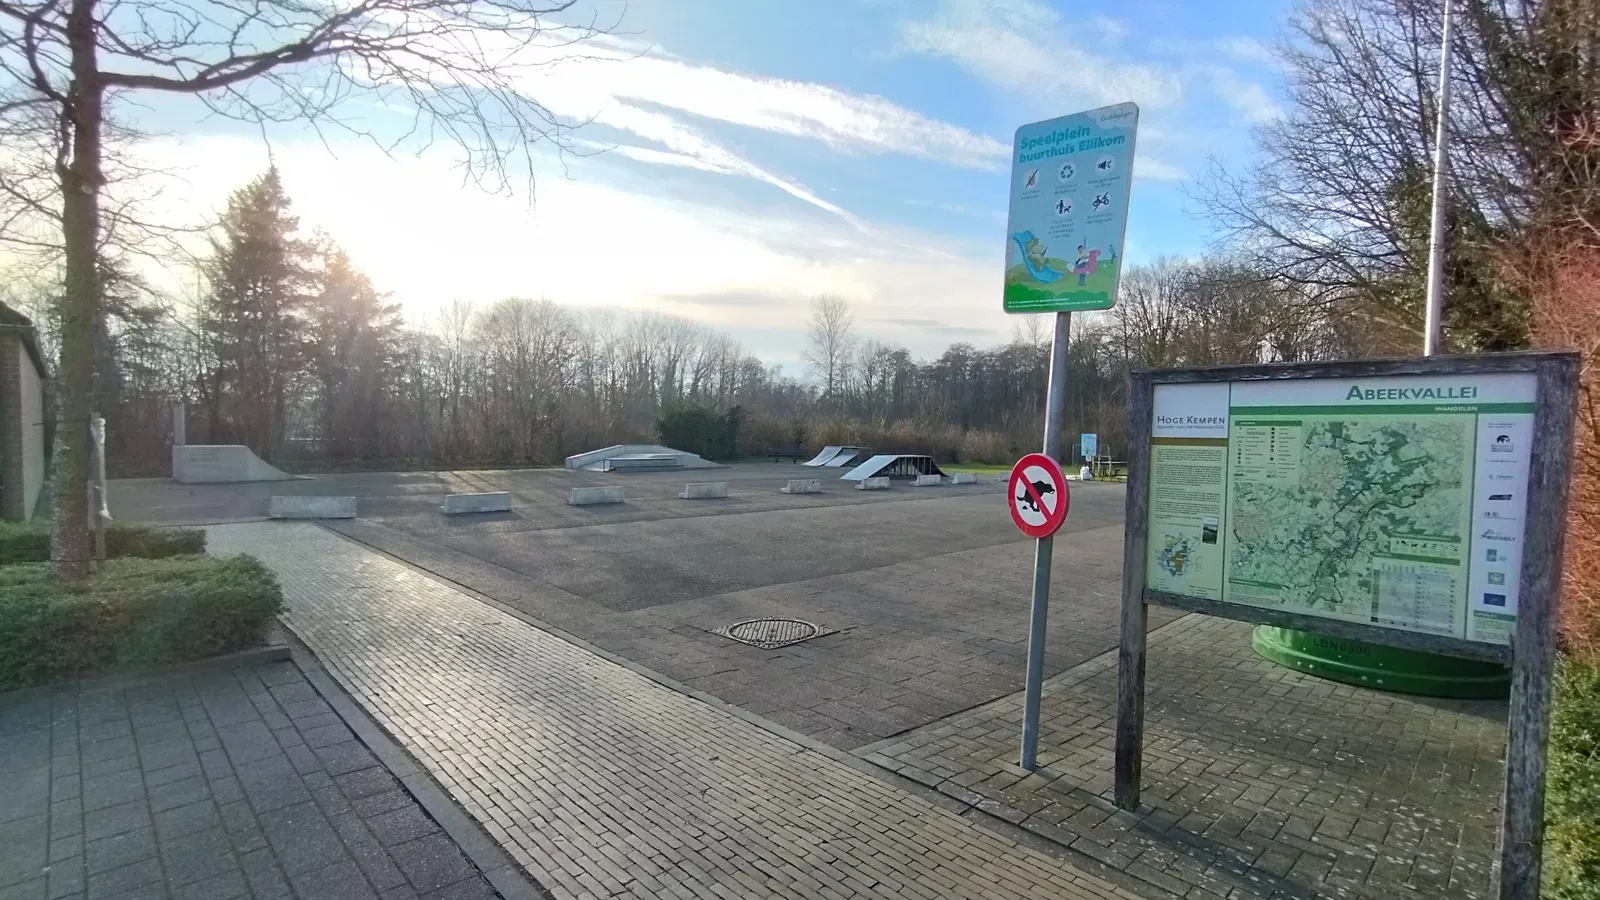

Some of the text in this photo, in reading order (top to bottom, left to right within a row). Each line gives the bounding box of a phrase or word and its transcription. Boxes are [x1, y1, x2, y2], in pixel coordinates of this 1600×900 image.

[1020, 135, 1125, 163] buurthuis Ellikom
[1021, 126, 1090, 151] Speelplein
[1157, 416, 1225, 424] HOGE KEMPEN
